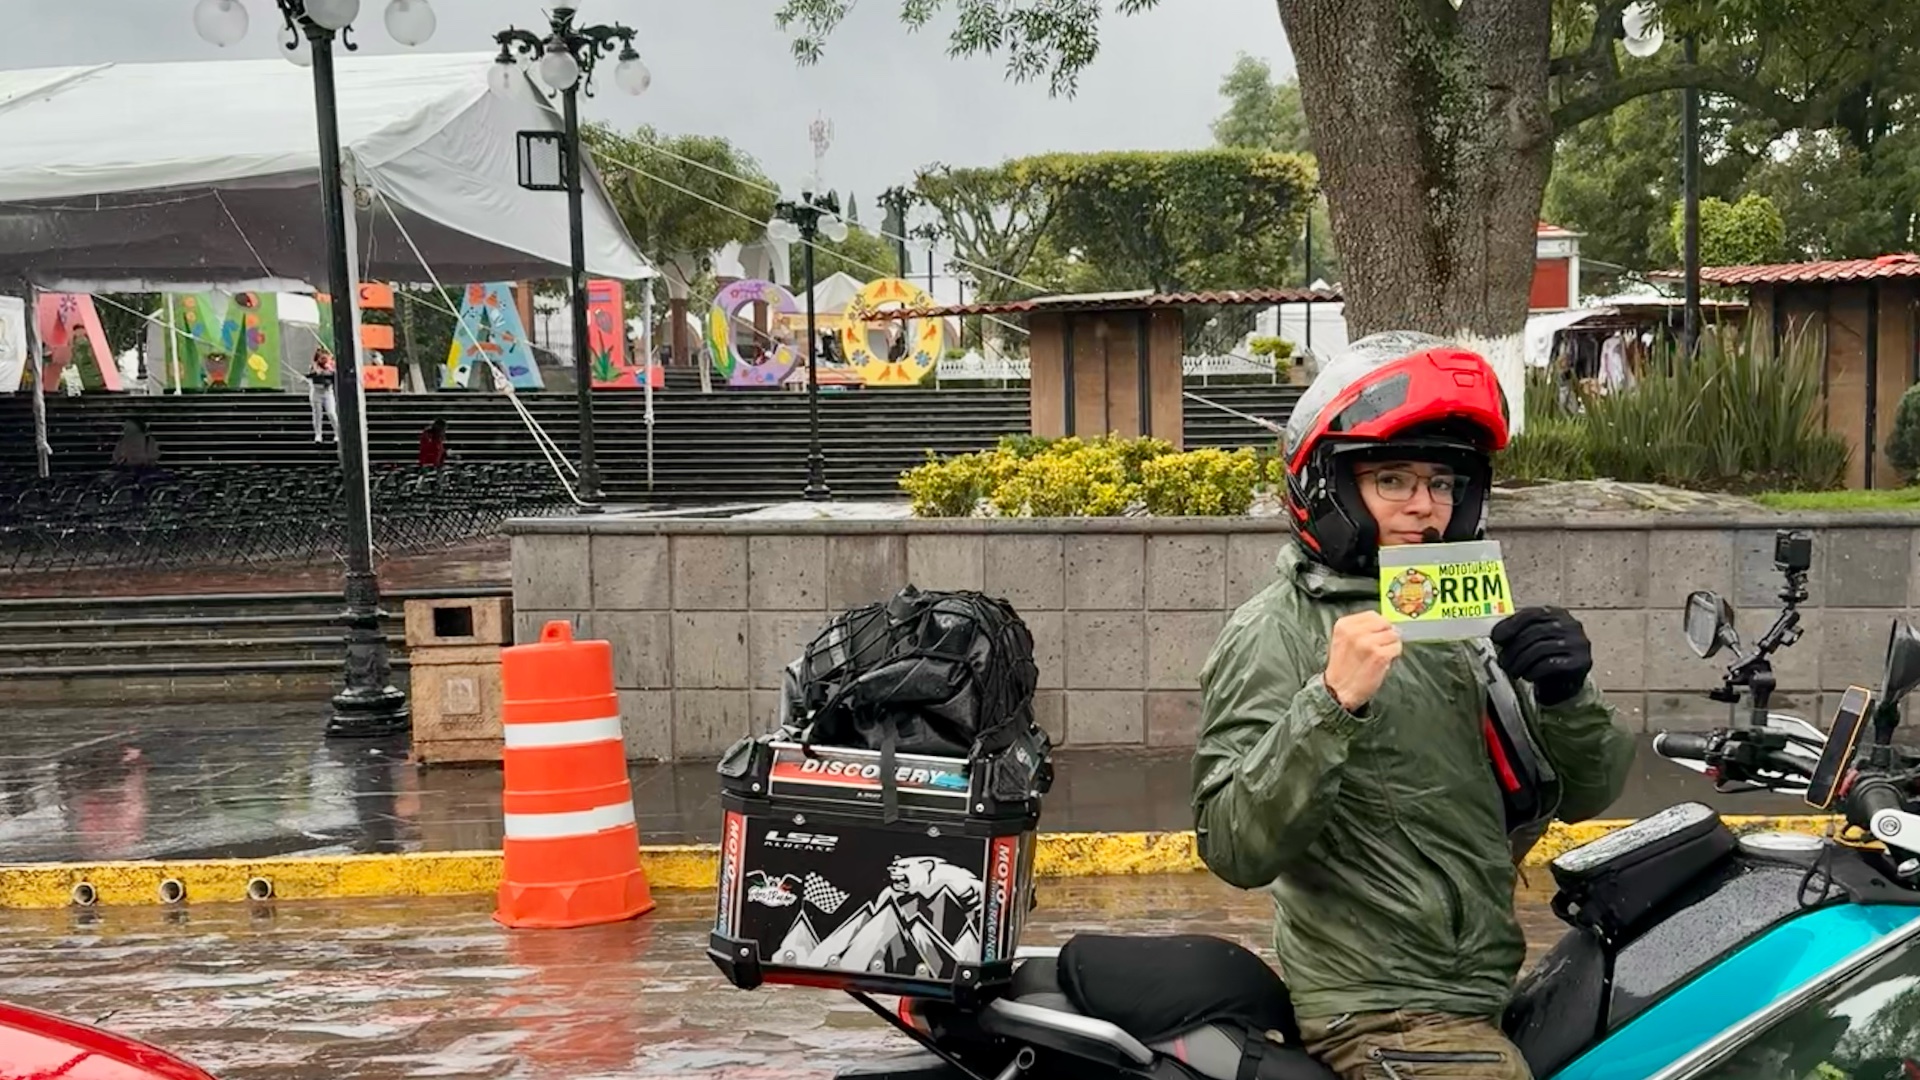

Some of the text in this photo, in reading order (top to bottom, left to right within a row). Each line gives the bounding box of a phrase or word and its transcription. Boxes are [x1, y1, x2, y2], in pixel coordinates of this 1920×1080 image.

[38, 278, 944, 391] AMEALCO
[1439, 562, 1500, 576] MOTOTURISTA
[1440, 574, 1503, 604] RRM
[801, 759, 946, 785] DISCOERY
[728, 820, 740, 881] MOTO
[764, 830, 839, 846] LS2
[996, 845, 1010, 904] MOTO
[985, 908, 999, 961] RACING
